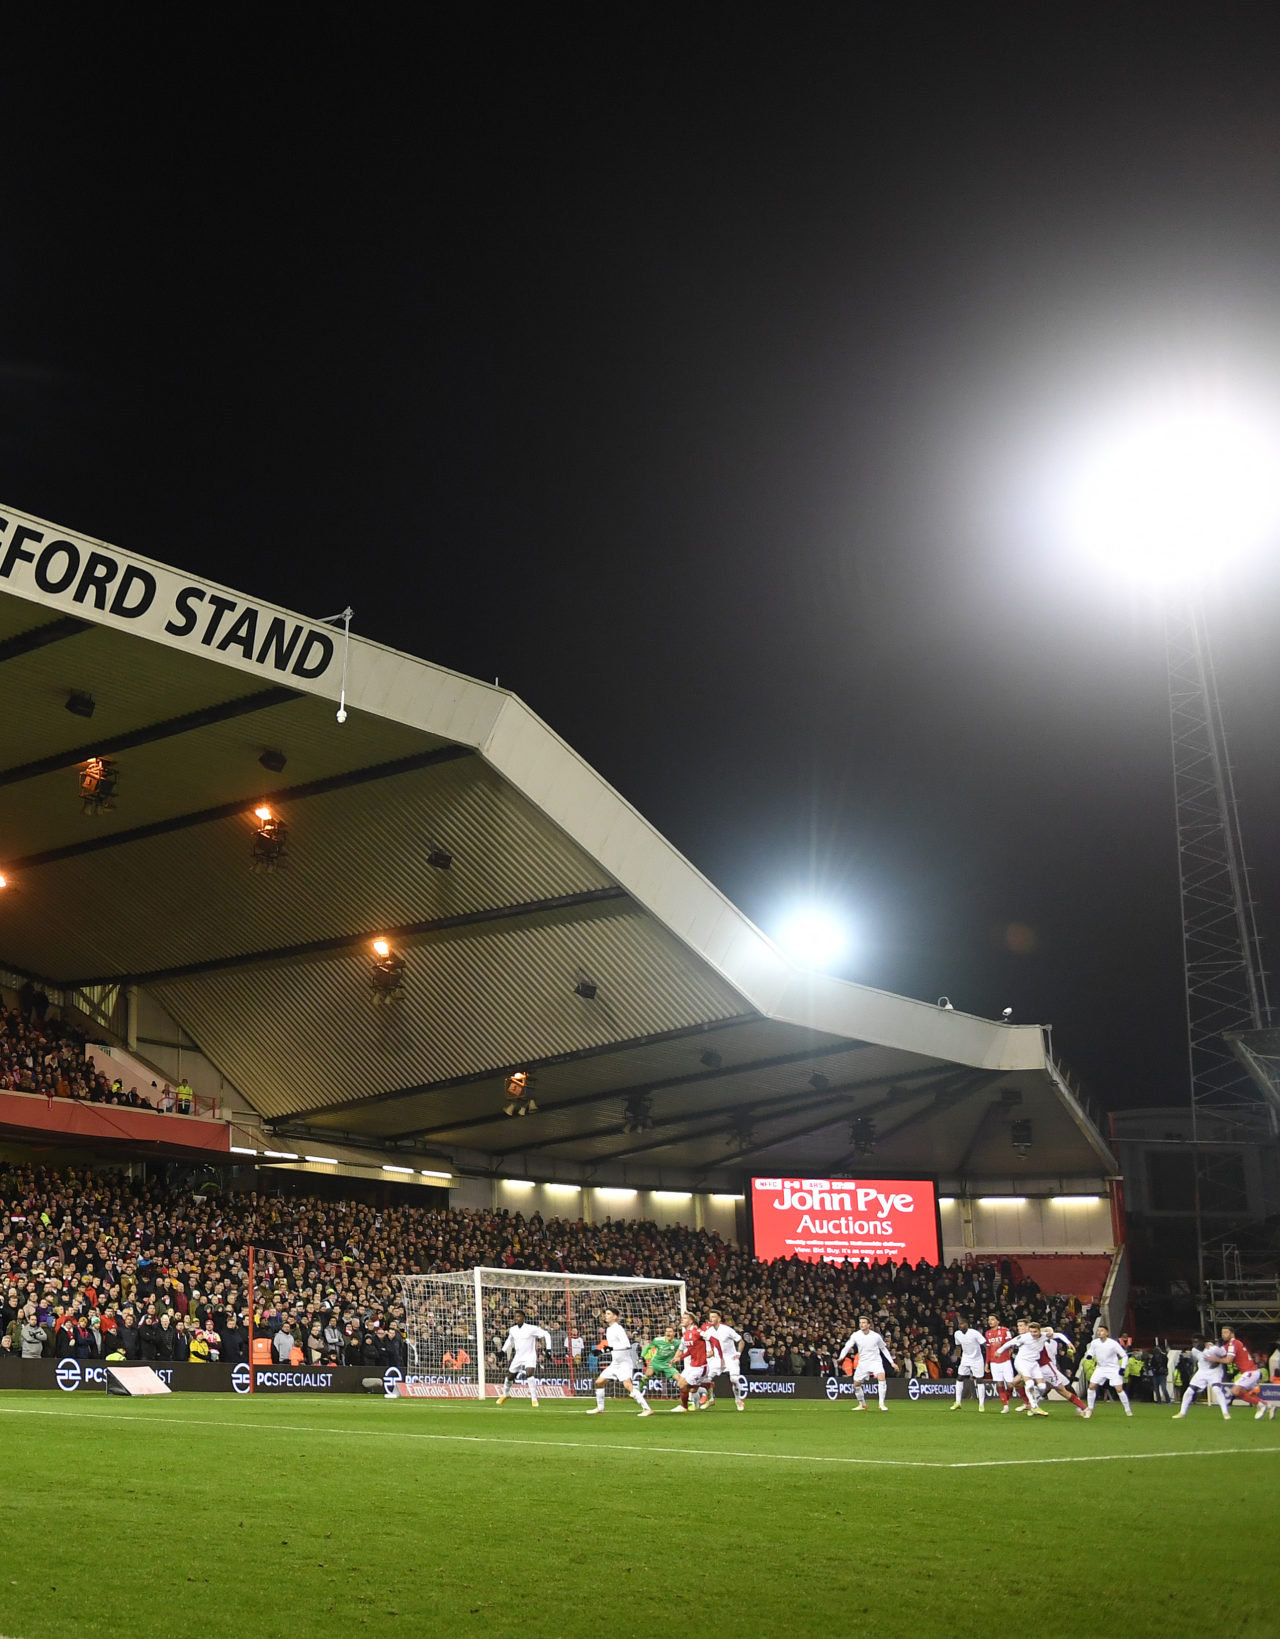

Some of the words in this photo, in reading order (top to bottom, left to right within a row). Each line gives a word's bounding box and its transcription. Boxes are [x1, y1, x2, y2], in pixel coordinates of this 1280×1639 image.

[164, 586, 334, 679] STAND
[773, 1187, 852, 1211] John
[856, 1188, 914, 1218] Pye
[797, 1214, 893, 1235] Auctions
[256, 1372, 332, 1387] PCSPECIALIST
[749, 1382, 796, 1394] PCSPECIALIST
